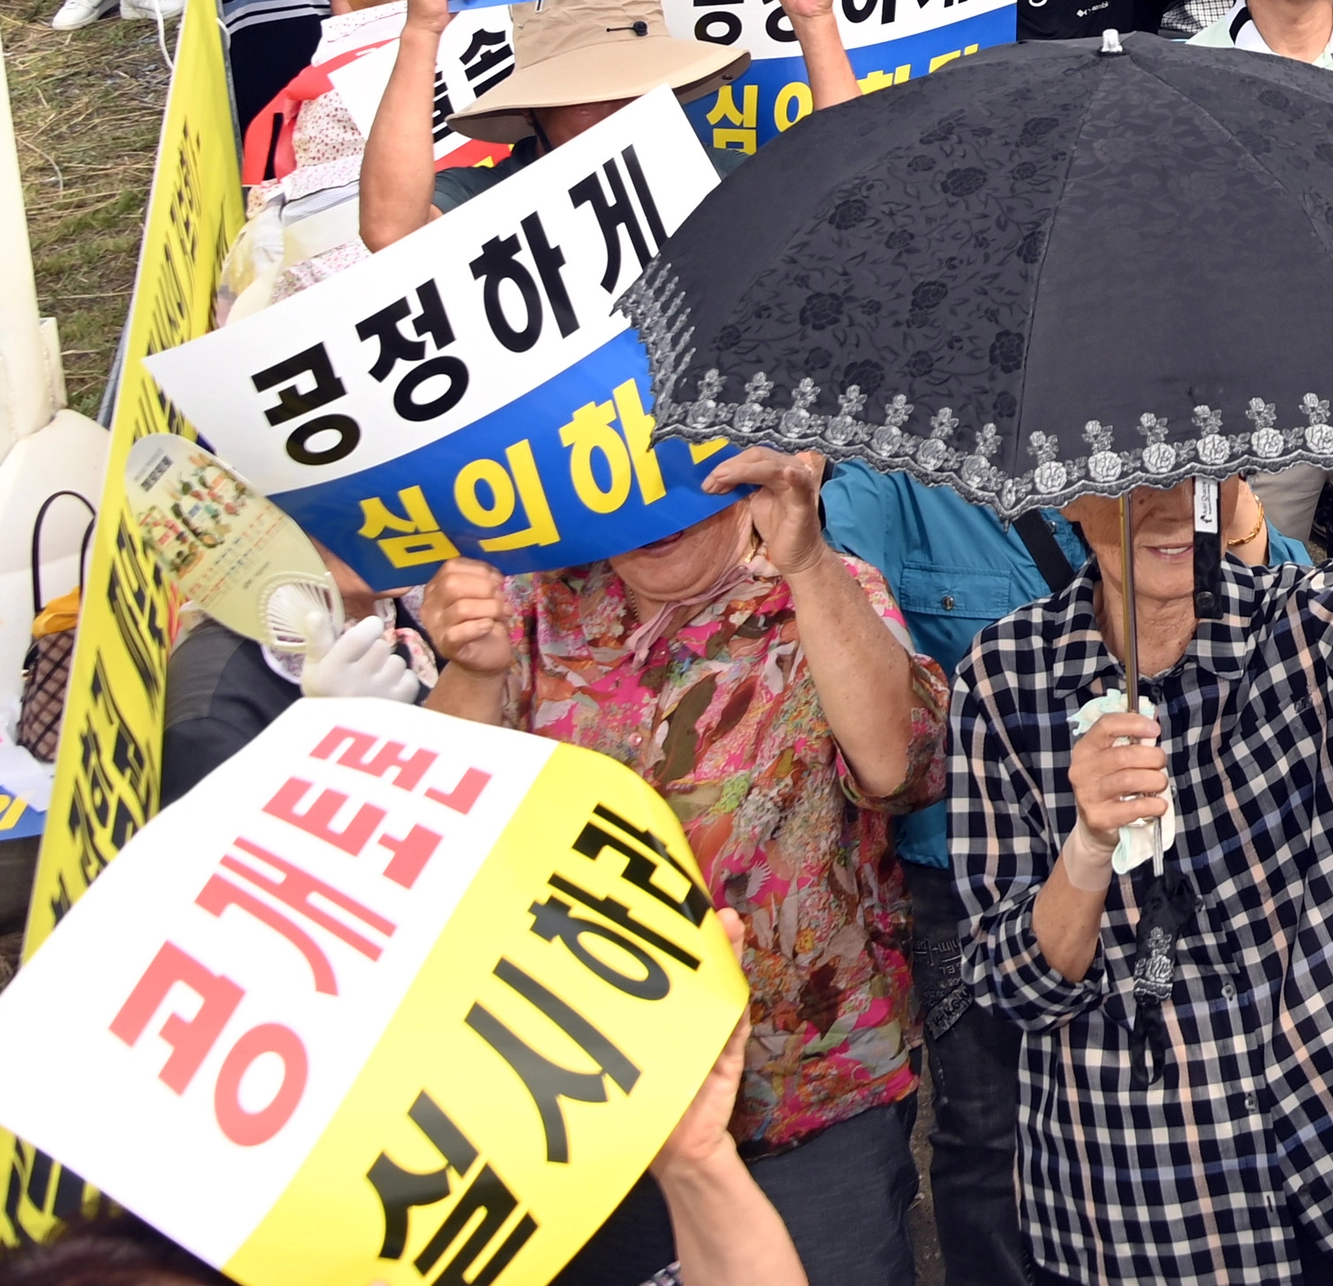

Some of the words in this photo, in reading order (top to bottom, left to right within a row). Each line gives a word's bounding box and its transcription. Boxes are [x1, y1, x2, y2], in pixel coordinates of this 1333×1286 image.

[250, 143, 670, 467] 공정하게
[357, 377, 712, 572] 심의하
[108, 725, 493, 1147] 공개토론
[365, 802, 713, 1286] 실시하라
